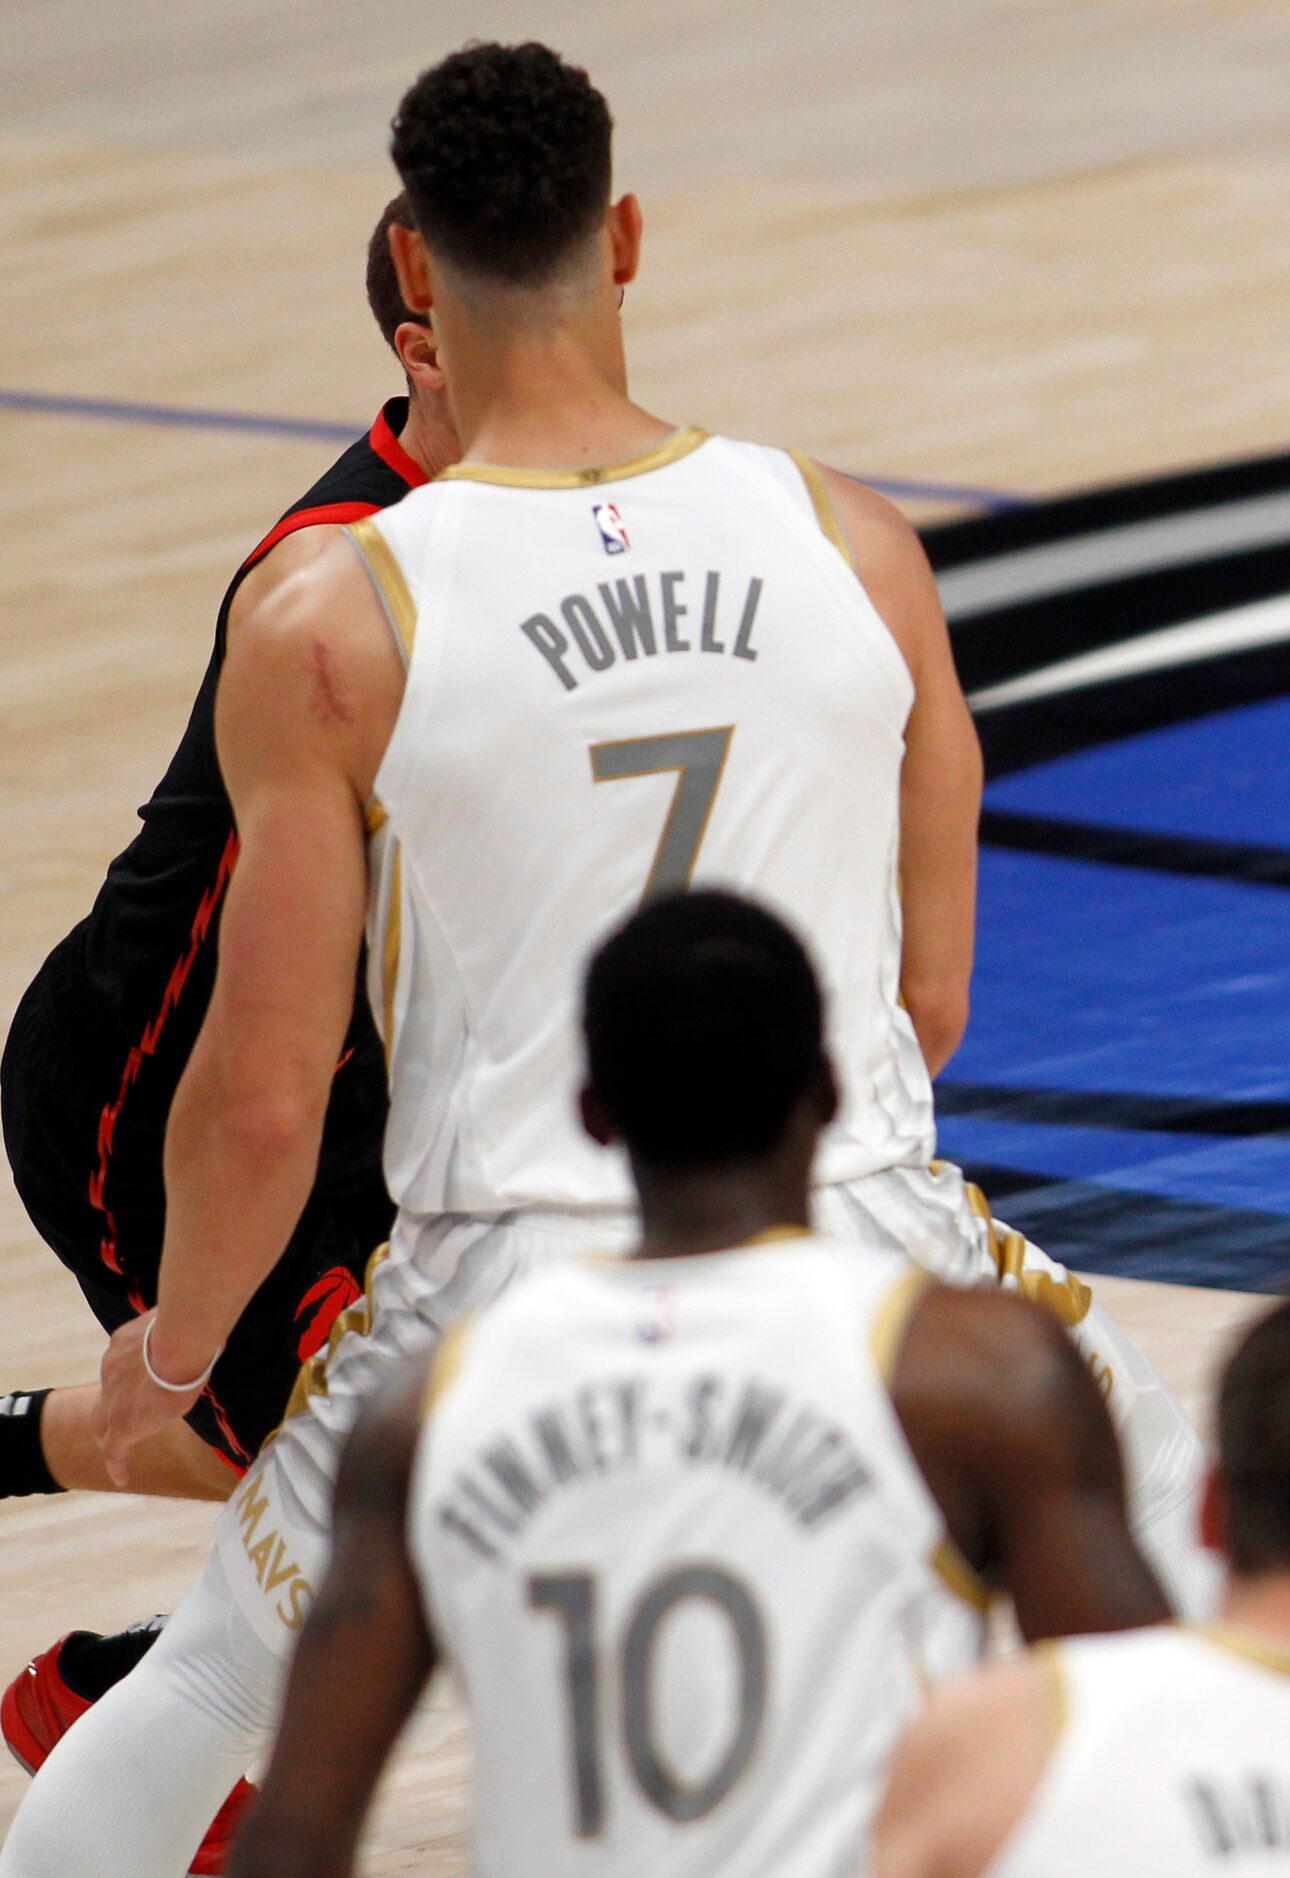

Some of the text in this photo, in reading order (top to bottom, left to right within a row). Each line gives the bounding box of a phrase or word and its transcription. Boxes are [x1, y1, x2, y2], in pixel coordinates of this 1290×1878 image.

[520, 570, 763, 691] POWELL
[589, 725, 736, 904] 7
[236, 1471, 314, 1630] MAVS
[525, 1562, 769, 1841] 10
